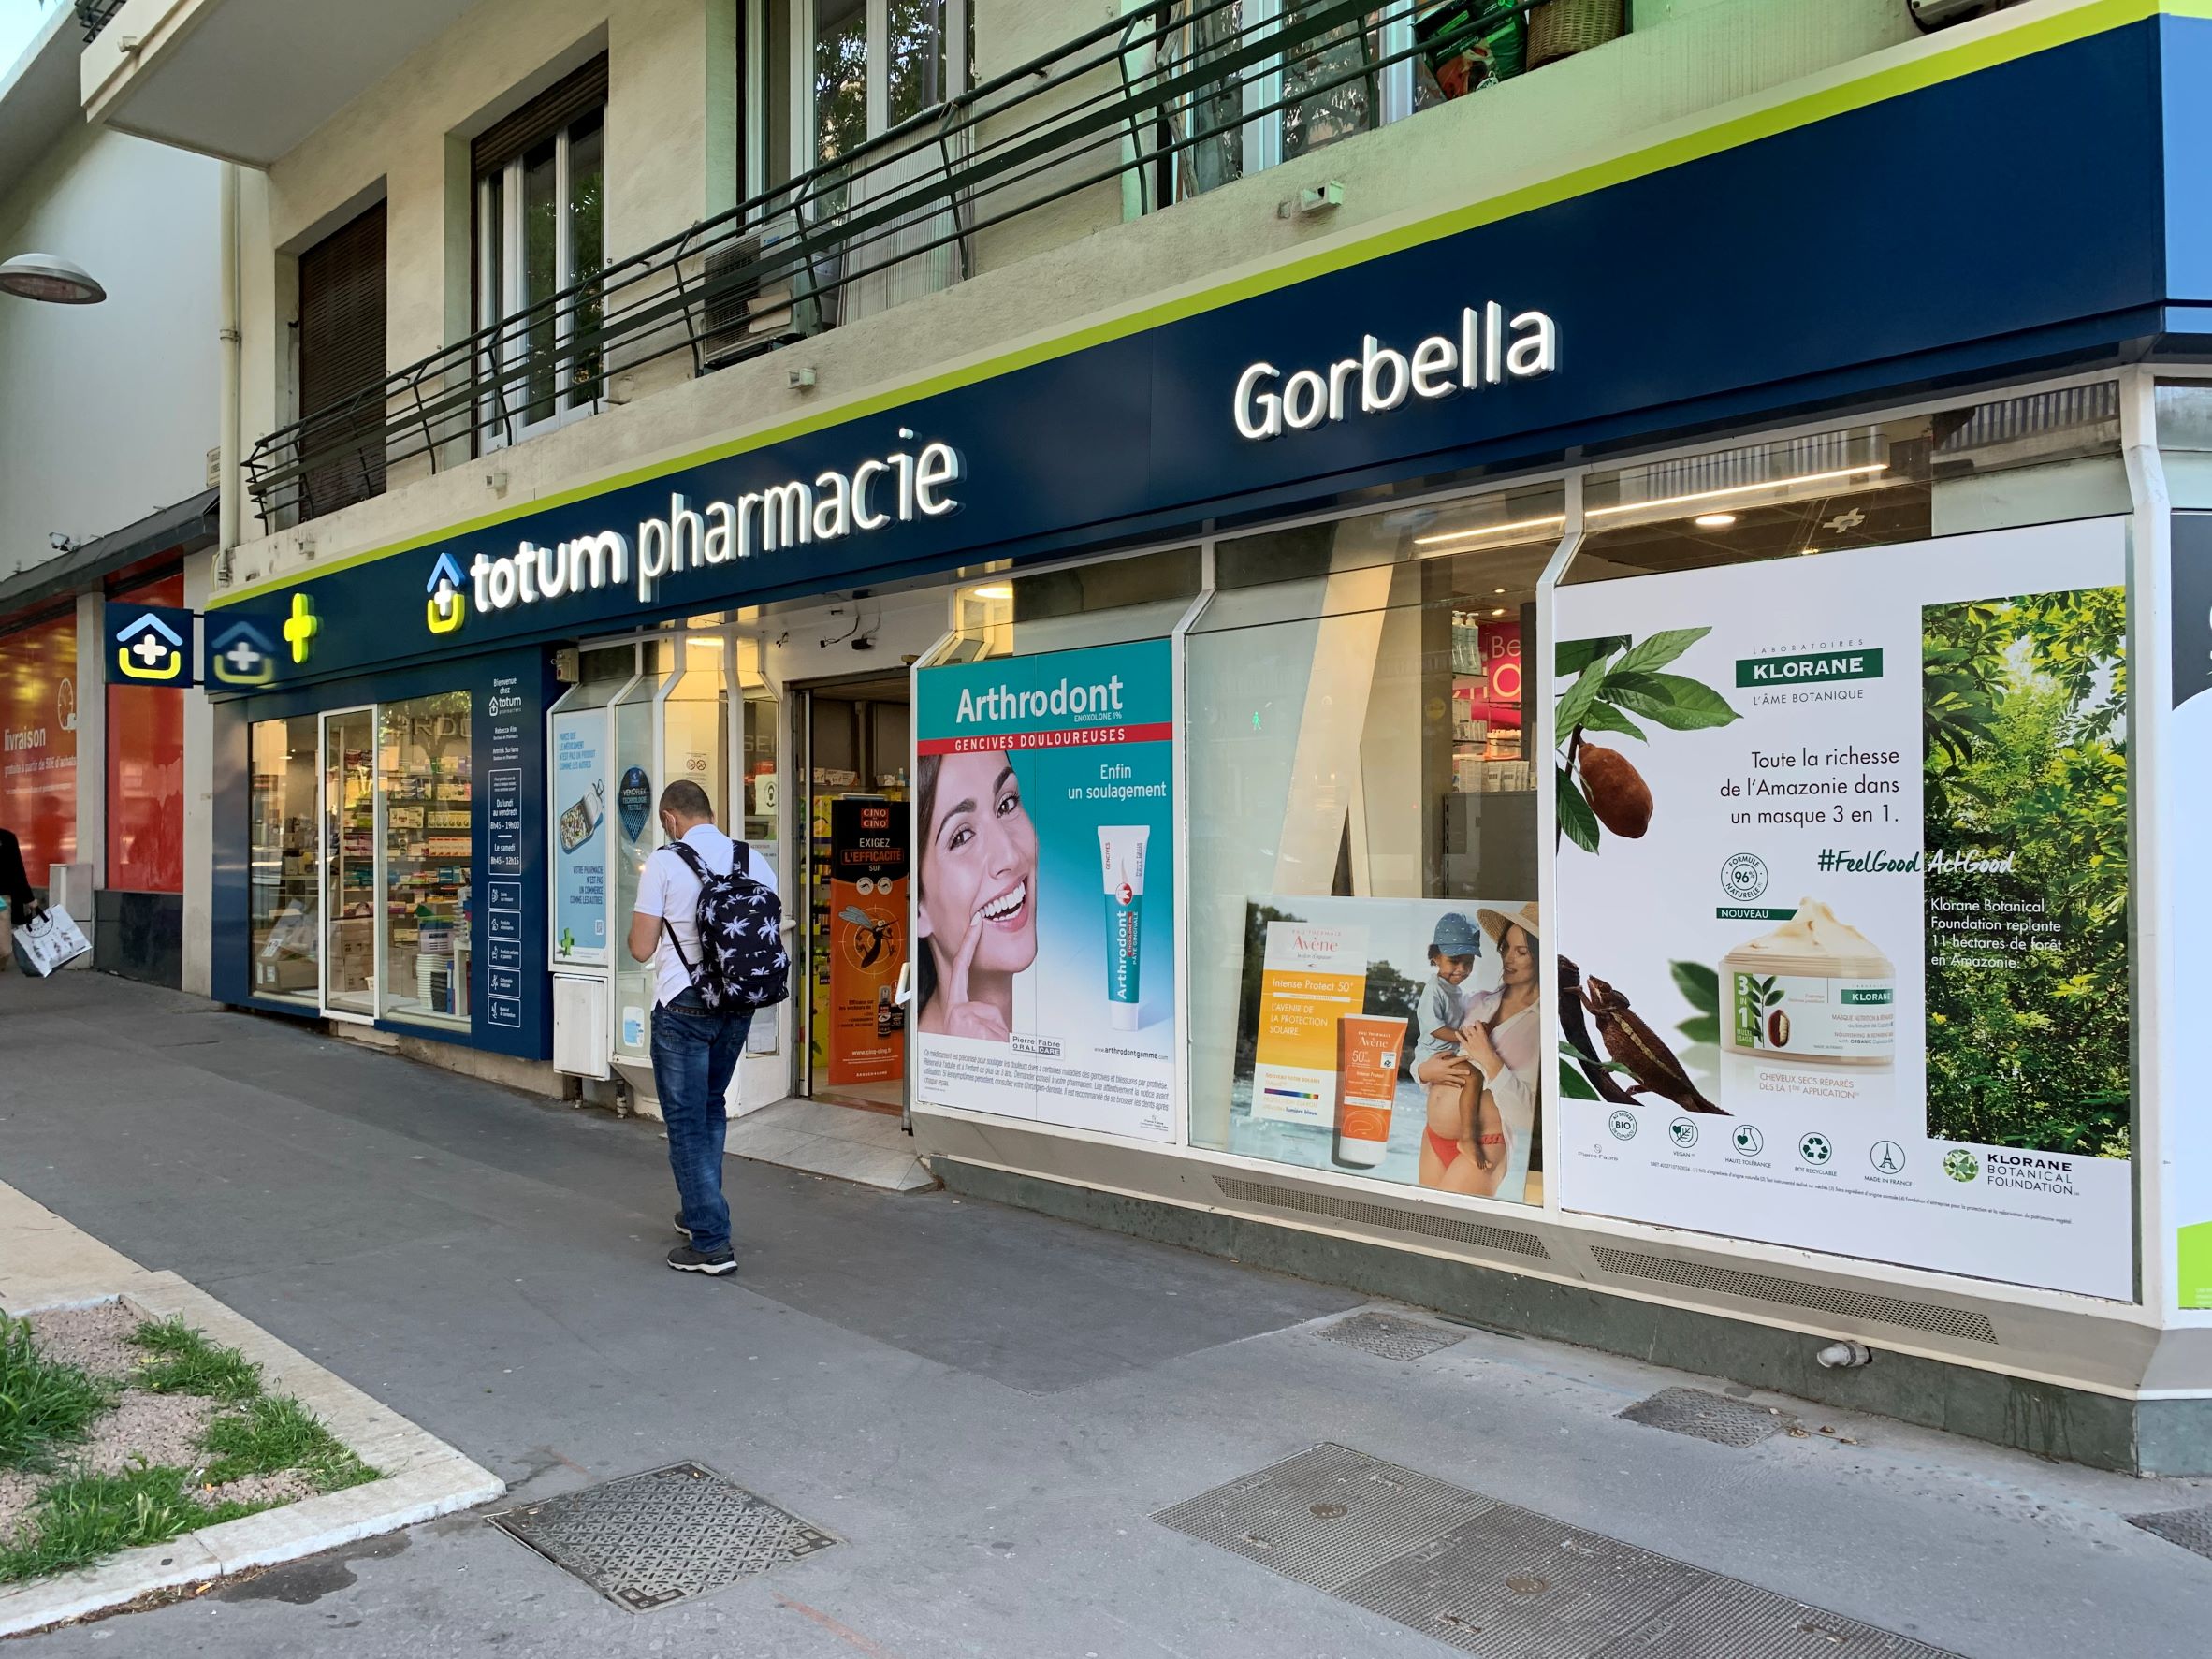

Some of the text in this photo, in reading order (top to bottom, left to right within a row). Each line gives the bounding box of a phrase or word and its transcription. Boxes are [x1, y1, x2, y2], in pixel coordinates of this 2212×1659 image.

[1234, 300, 1555, 440] Gorbella
[471, 428, 959, 612] totum pharmacie
[1753, 639, 1864, 654] LABORATOIRES
[1753, 657, 1864, 680] KLORANE
[498, 696, 522, 707] totum
[956, 675, 1123, 723] Arthrodont
[1753, 689, 1864, 706] L'ÂME BOTANIQUE
[1074, 713, 1112, 722] ENOXOLONE
[4, 726, 46, 751] livraison
[955, 728, 1126, 751] GENCIVES DOULOUREUSES
[1752, 745, 1899, 768] Toute la richesse
[1100, 764, 1131, 779] Enfin
[1068, 781, 1167, 802] un soulagement
[1720, 773, 1899, 796] de l'Amazonie dans
[1731, 810, 1751, 824] un
[1757, 810, 1826, 828] masque
[1833, 805, 1844, 822] 3
[1851, 809, 1872, 822] en
[859, 837, 891, 848] EXIGEZ
[1729, 855, 1760, 867] FORMULE
[1817, 849, 2016, 874] #FeelGood ActGood
[1734, 871, 1755, 883] 96%
[1725, 882, 1761, 898] NATURELLE
[1931, 897, 2045, 912] Klorane Botanical
[1721, 910, 1768, 919] NOUVEAU
[1931, 916, 2061, 935] Foundation replante
[1292, 935, 1339, 953] Avène
[1932, 934, 2061, 951] 11 hectares de forêt
[1117, 910, 1127, 1000] Arthrodont
[1931, 955, 1946, 966] en
[1272, 978, 1302, 989] Intense
[1305, 980, 1334, 991] Protect
[1738, 975, 1749, 996] 3
[1852, 992, 1891, 1001] KLORANE
[1271, 1003, 1315, 1013] L'AVENIR DE
[1271, 1014, 1328, 1026] LA PROTECTION
[1738, 1007, 1748, 1028] 1
[1012, 1036, 1060, 1048] Pierre Fabre
[1012, 1043, 1060, 1055] ORAL CARE
[1361, 1036, 1389, 1048] Avène
[1759, 1072, 1855, 1088] CHEVEUX SECS RÉPARÉS
[1759, 1083, 1774, 1091] DÈS
[1615, 1121, 1631, 1130] BIO
[1742, 1158, 1772, 1169] TOLÉRANCE
[1987, 1153, 2073, 1171] KLORANE
[1805, 1168, 1838, 1177] RECYCLABLE
[1987, 1164, 2073, 1184] BOTANICAL
[1889, 1178, 1913, 1187] FRANCE
[1987, 1175, 2074, 1196] FOUNDATION
